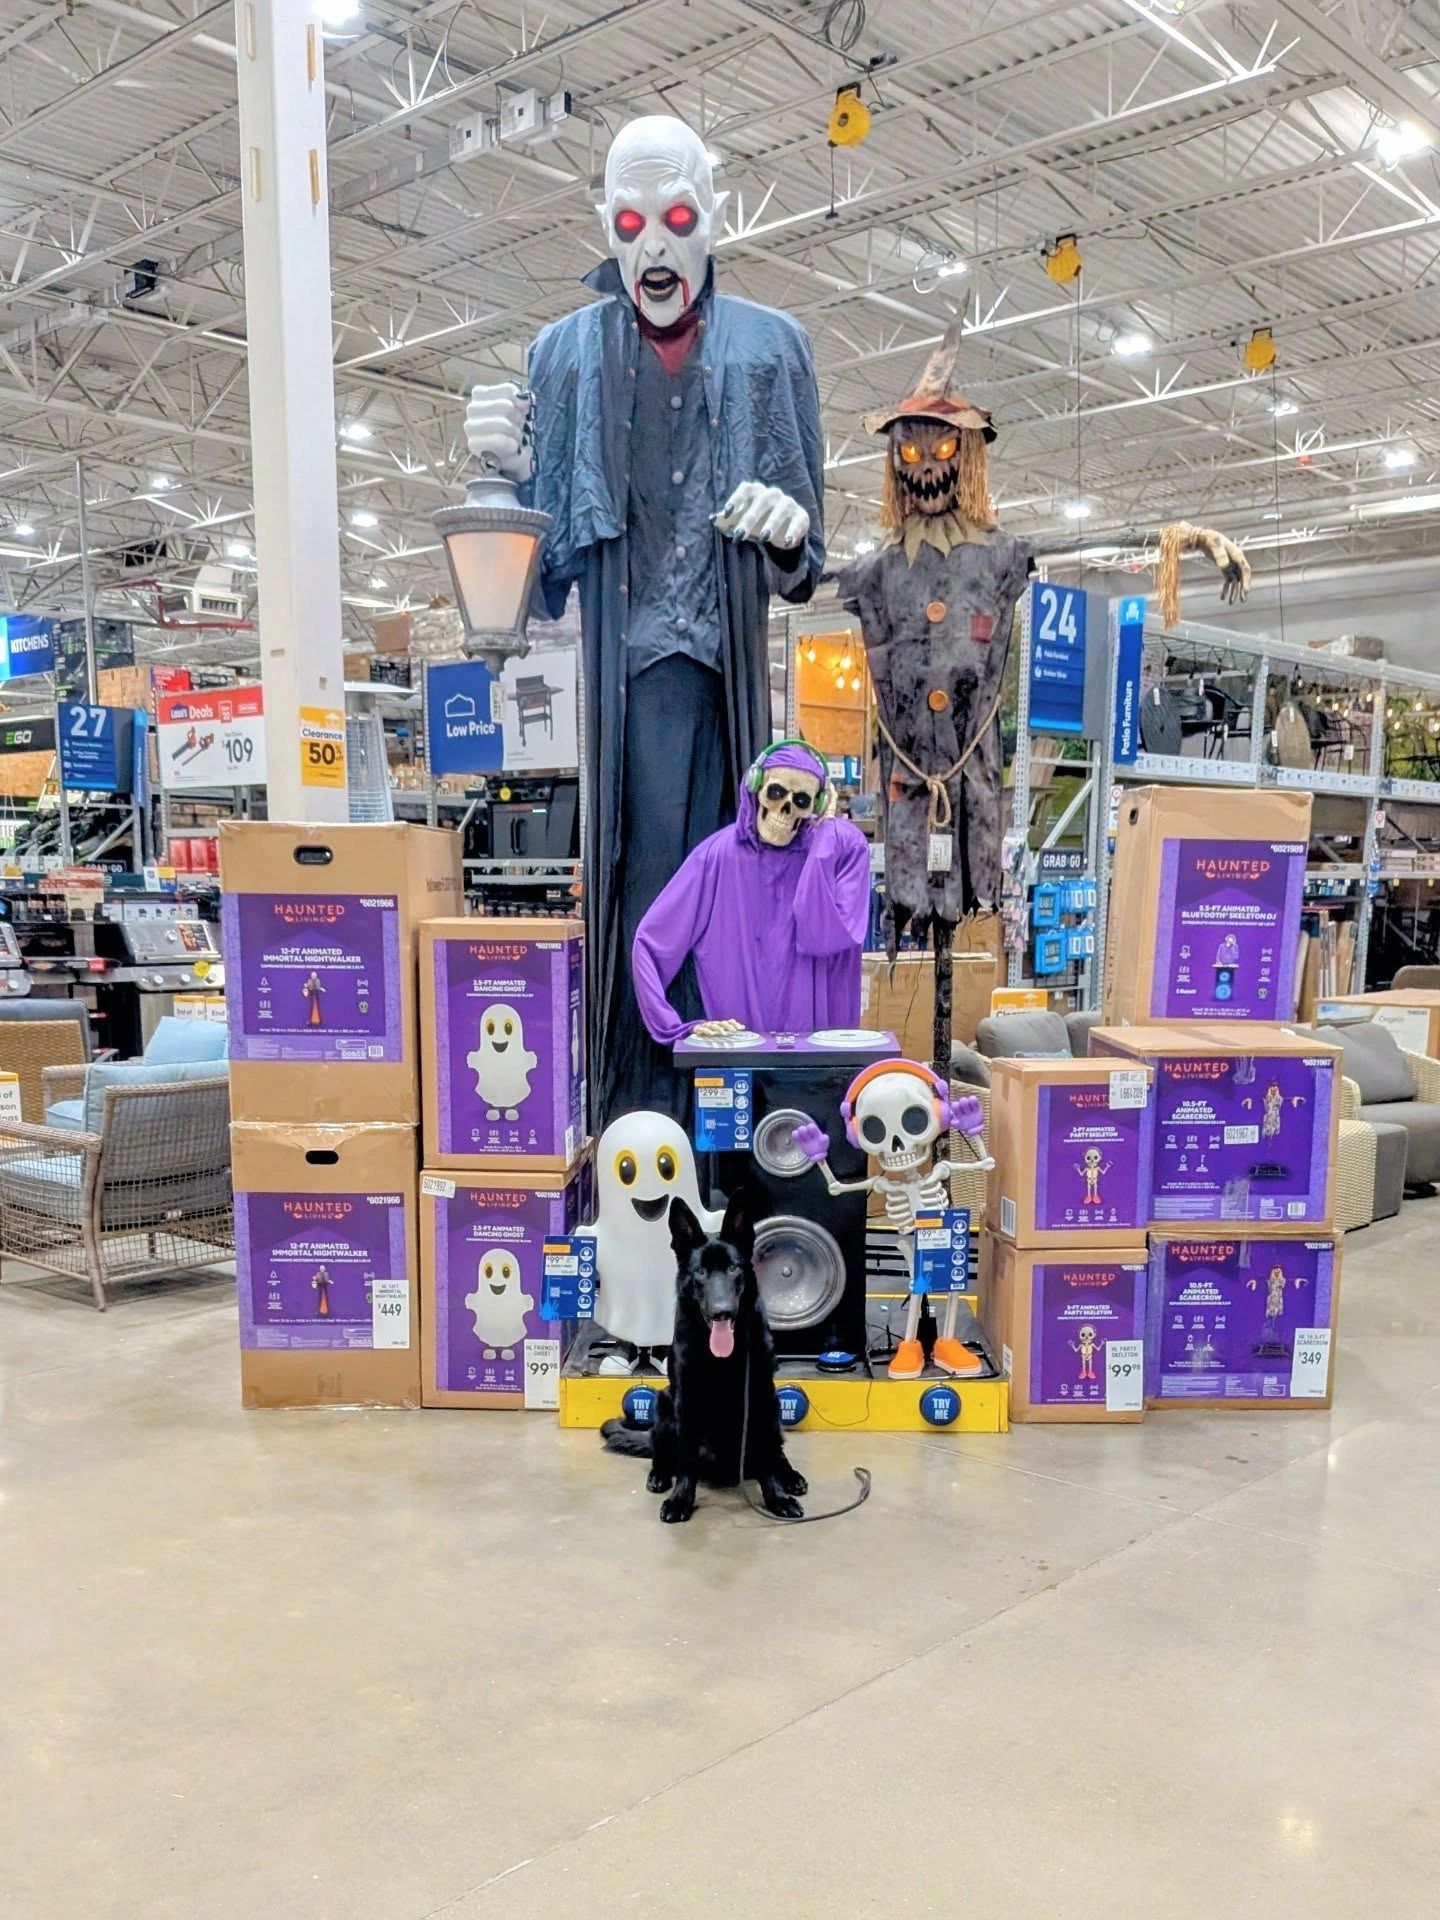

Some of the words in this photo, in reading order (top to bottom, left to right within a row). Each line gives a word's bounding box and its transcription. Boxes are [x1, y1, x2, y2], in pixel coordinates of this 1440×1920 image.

[1039, 589, 1077, 644] 24
[11, 635, 49, 653] KITCHENS
[1122, 680, 1133, 727] Furniture
[189, 704, 214, 718] Deals
[70, 706, 107, 737] 27
[302, 728, 343, 740] Clearance
[446, 722, 467, 738] Low
[469, 721, 496, 736] Price
[6, 730, 32, 745] EGO
[1121, 728, 1131, 755] Patio
[309, 742, 336, 765] 50
[1043, 854, 1067, 868] GRAB
[1070, 854, 1081, 868] GO
[1196, 860, 1270, 872] HAUNTED
[274, 904, 345, 915] HAUNTED
[1222, 905, 1261, 913] ANIMATED
[1229, 912, 1266, 920] SKELETON
[469, 945, 528, 954] HAUNTED
[304, 955, 362, 963] NIGHTWALKER
[1164, 1063, 1229, 1072] HAUNTED
[3, 1090, 13, 1099] of
[1070, 1094, 1109, 1102] HAUNT
[470, 1192, 527, 1202] HAUNTED
[283, 1202, 352, 1212] HAUNTED
[1171, 1246, 1234, 1255] HAUNTED
[1063, 1273, 1116, 1281] HAUNTED
[632, 1399, 651, 1410] TRY
[780, 1399, 798, 1410] TRY
[932, 1398, 951, 1409] TRY
[634, 1409, 649, 1420] ME
[781, 1409, 796, 1420] ME
[934, 1409, 949, 1420] ME
